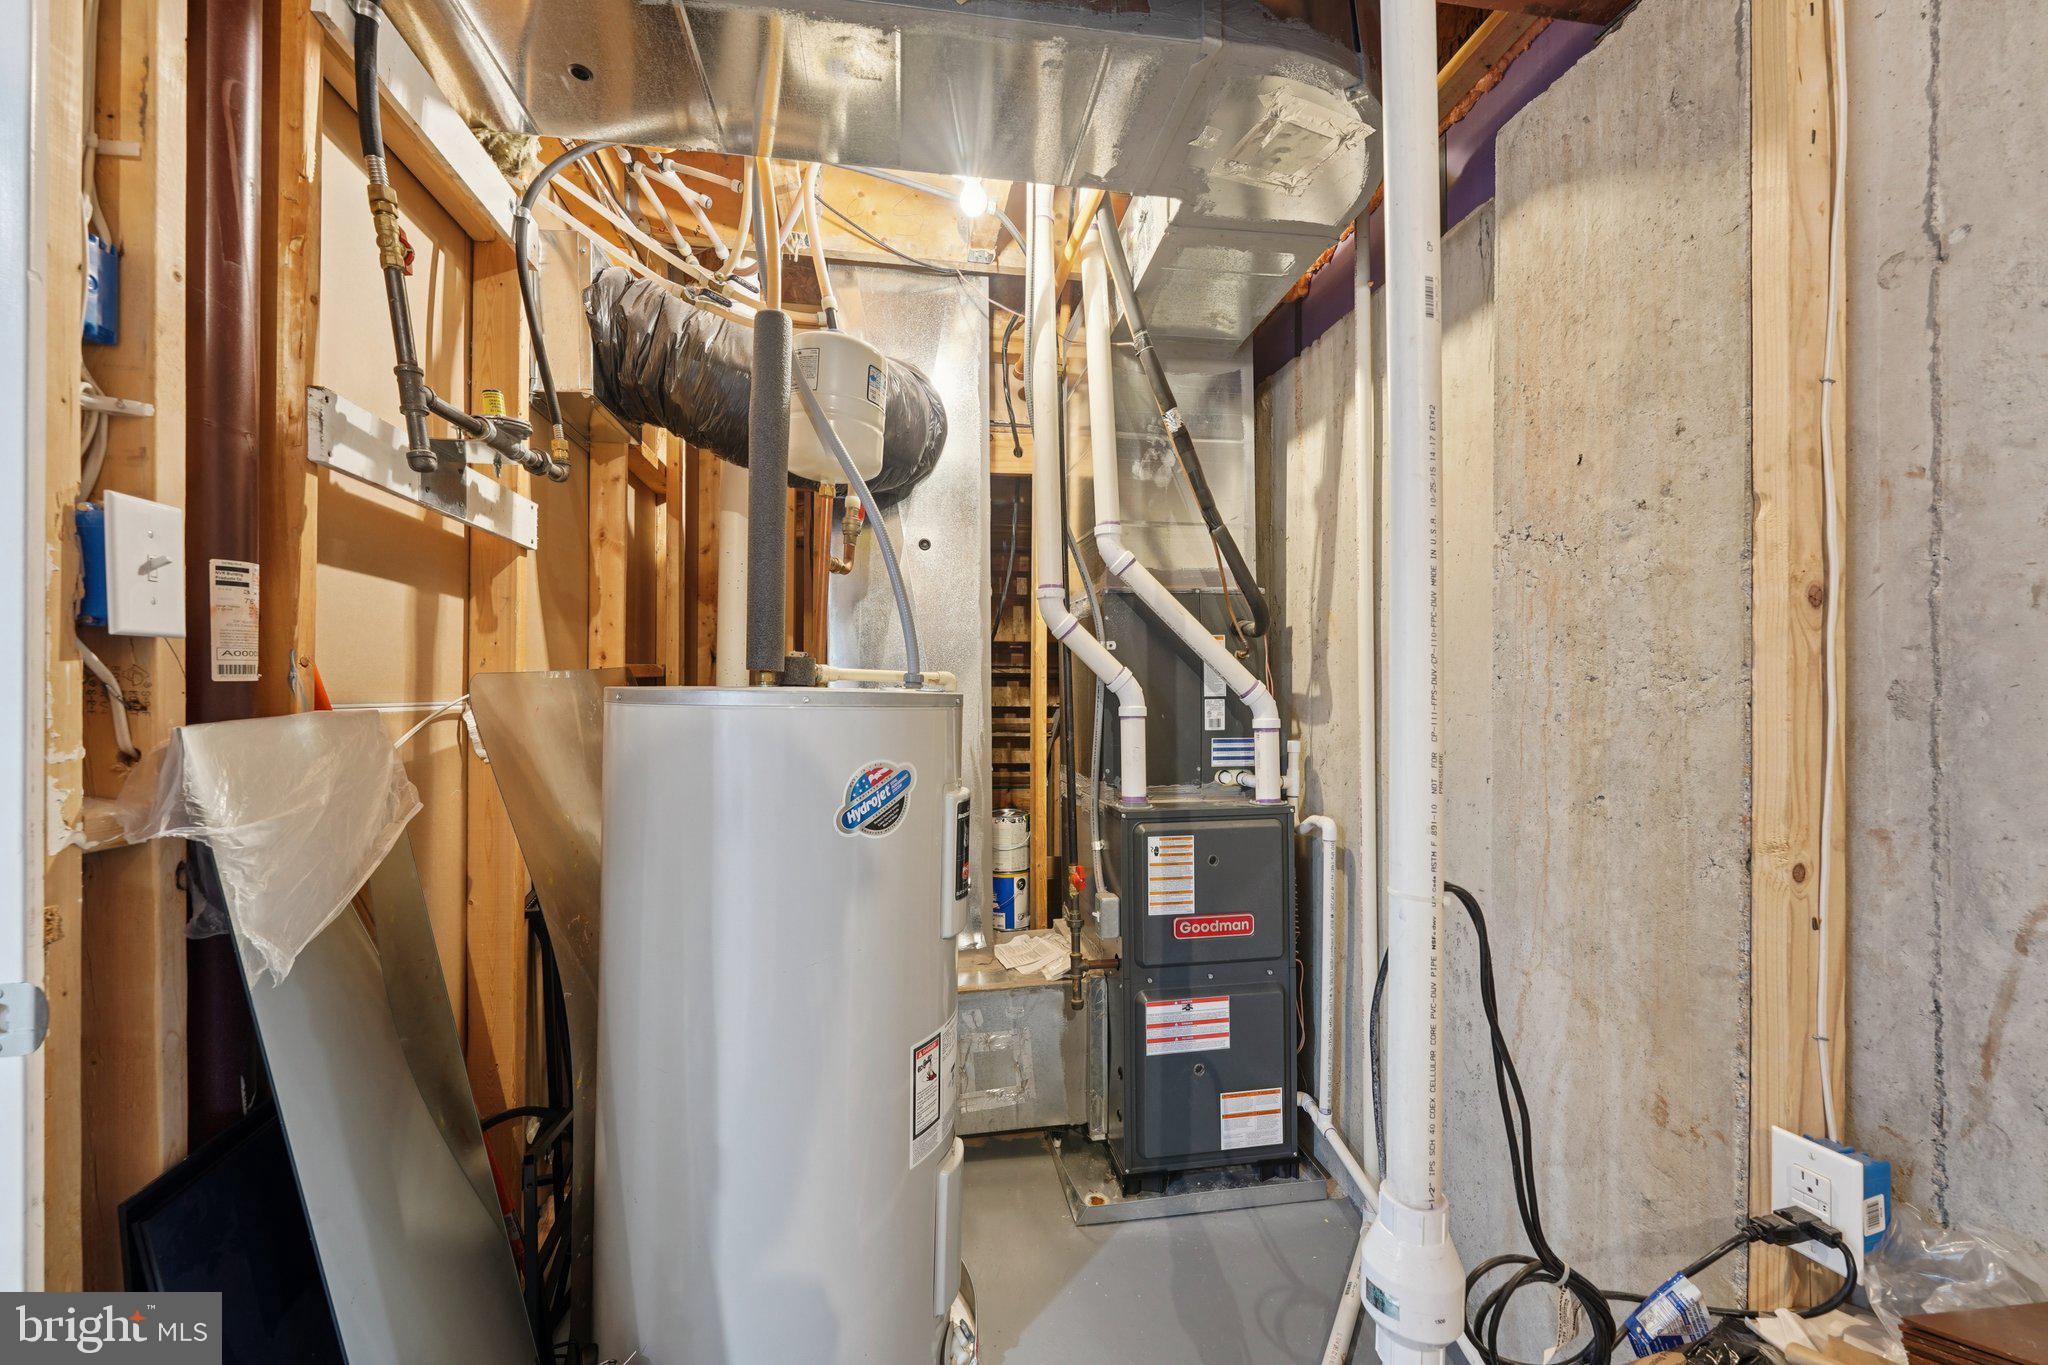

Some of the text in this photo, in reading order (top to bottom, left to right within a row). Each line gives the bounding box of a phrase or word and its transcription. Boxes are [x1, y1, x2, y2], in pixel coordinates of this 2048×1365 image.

[1430, 549, 1437, 560] IN
[846, 783, 892, 825] Hydrojet
[1180, 920, 1250, 934] Goodman
[1430, 956, 1438, 977] PIPE
[1429, 1124, 1435, 1135] 40
